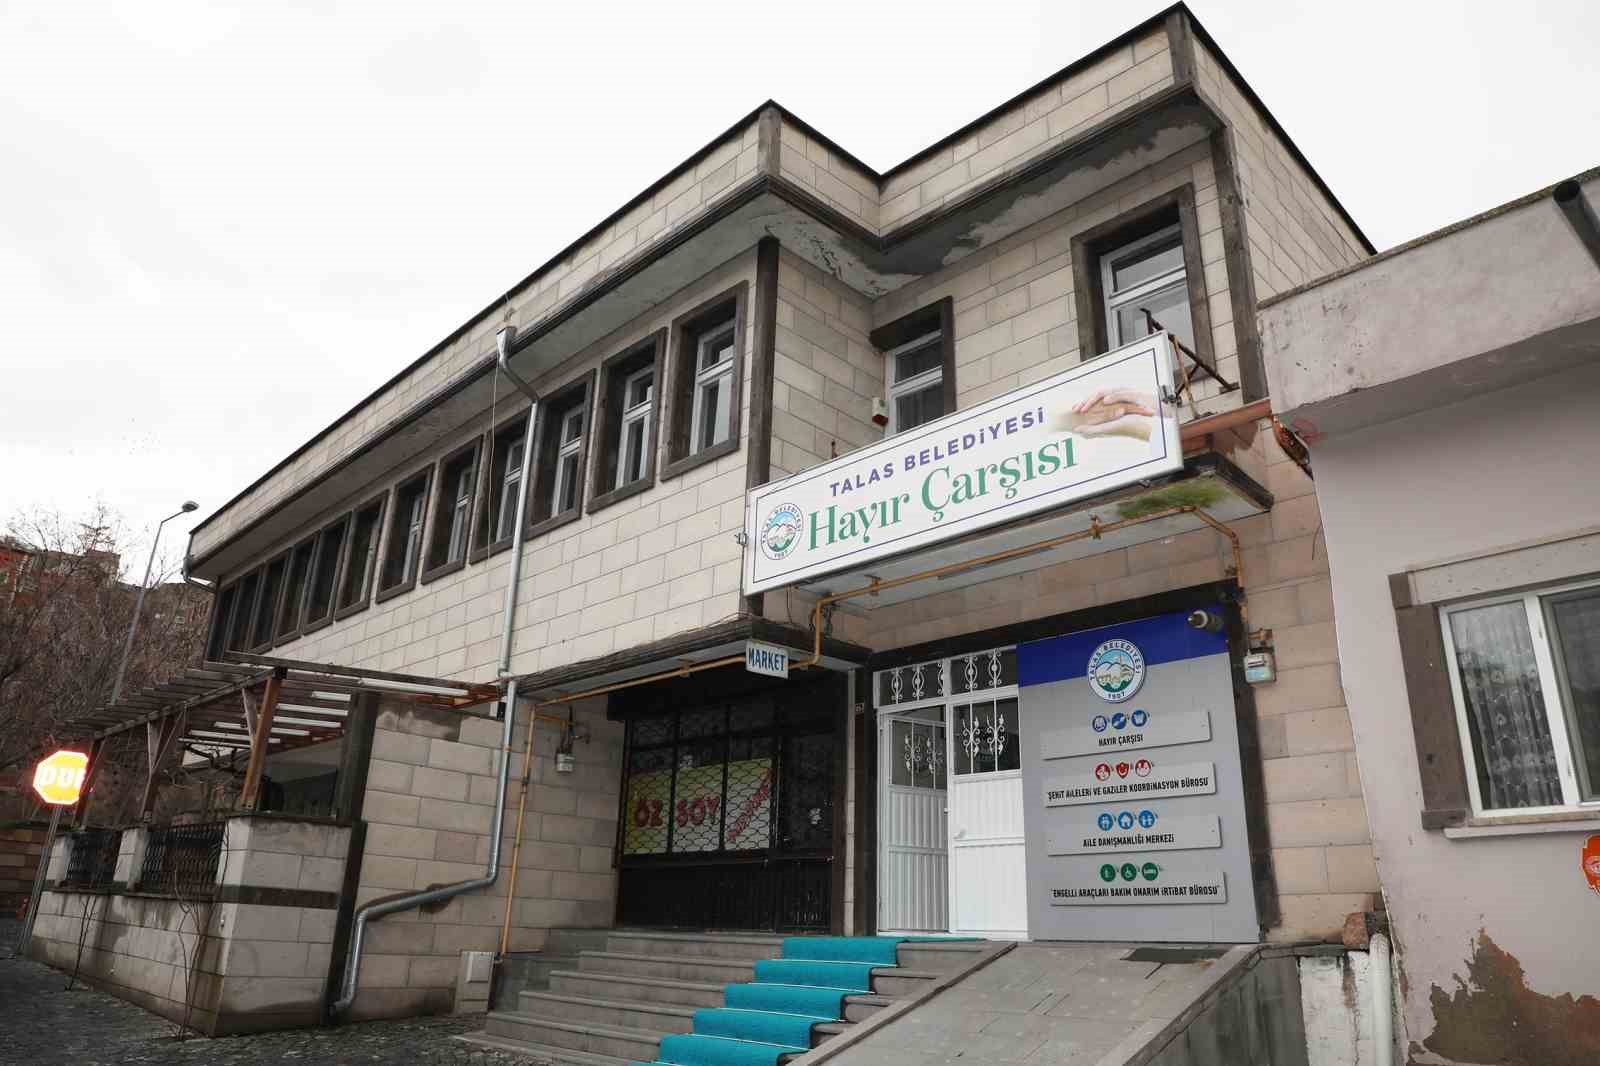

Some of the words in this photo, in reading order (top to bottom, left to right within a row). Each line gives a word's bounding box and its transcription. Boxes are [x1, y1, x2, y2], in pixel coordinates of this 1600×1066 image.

[830, 462, 894, 498] TALAS
[904, 406, 1046, 472] BELEDİYESİ
[806, 492, 911, 552] Hayır
[920, 436, 1079, 522] Çarşısı
[748, 647, 785, 672] MARKET
[1098, 735, 1117, 747] HAYIR
[1118, 734, 1144, 746] ÇARŞISI
[1093, 786, 1102, 797] VE
[1102, 783, 1128, 796] GAZİLER
[1181, 776, 1209, 789] BÜROSU
[1083, 837, 1097, 848] AİLE
[1098, 833, 1145, 848] DANIŞMANLIĞI
[1145, 833, 1175, 844] MERKEZİ
[1078, 887, 1109, 900] ARAÇLARI
[1110, 887, 1130, 898] BAKIM
[1132, 886, 1160, 897] ONARIM
